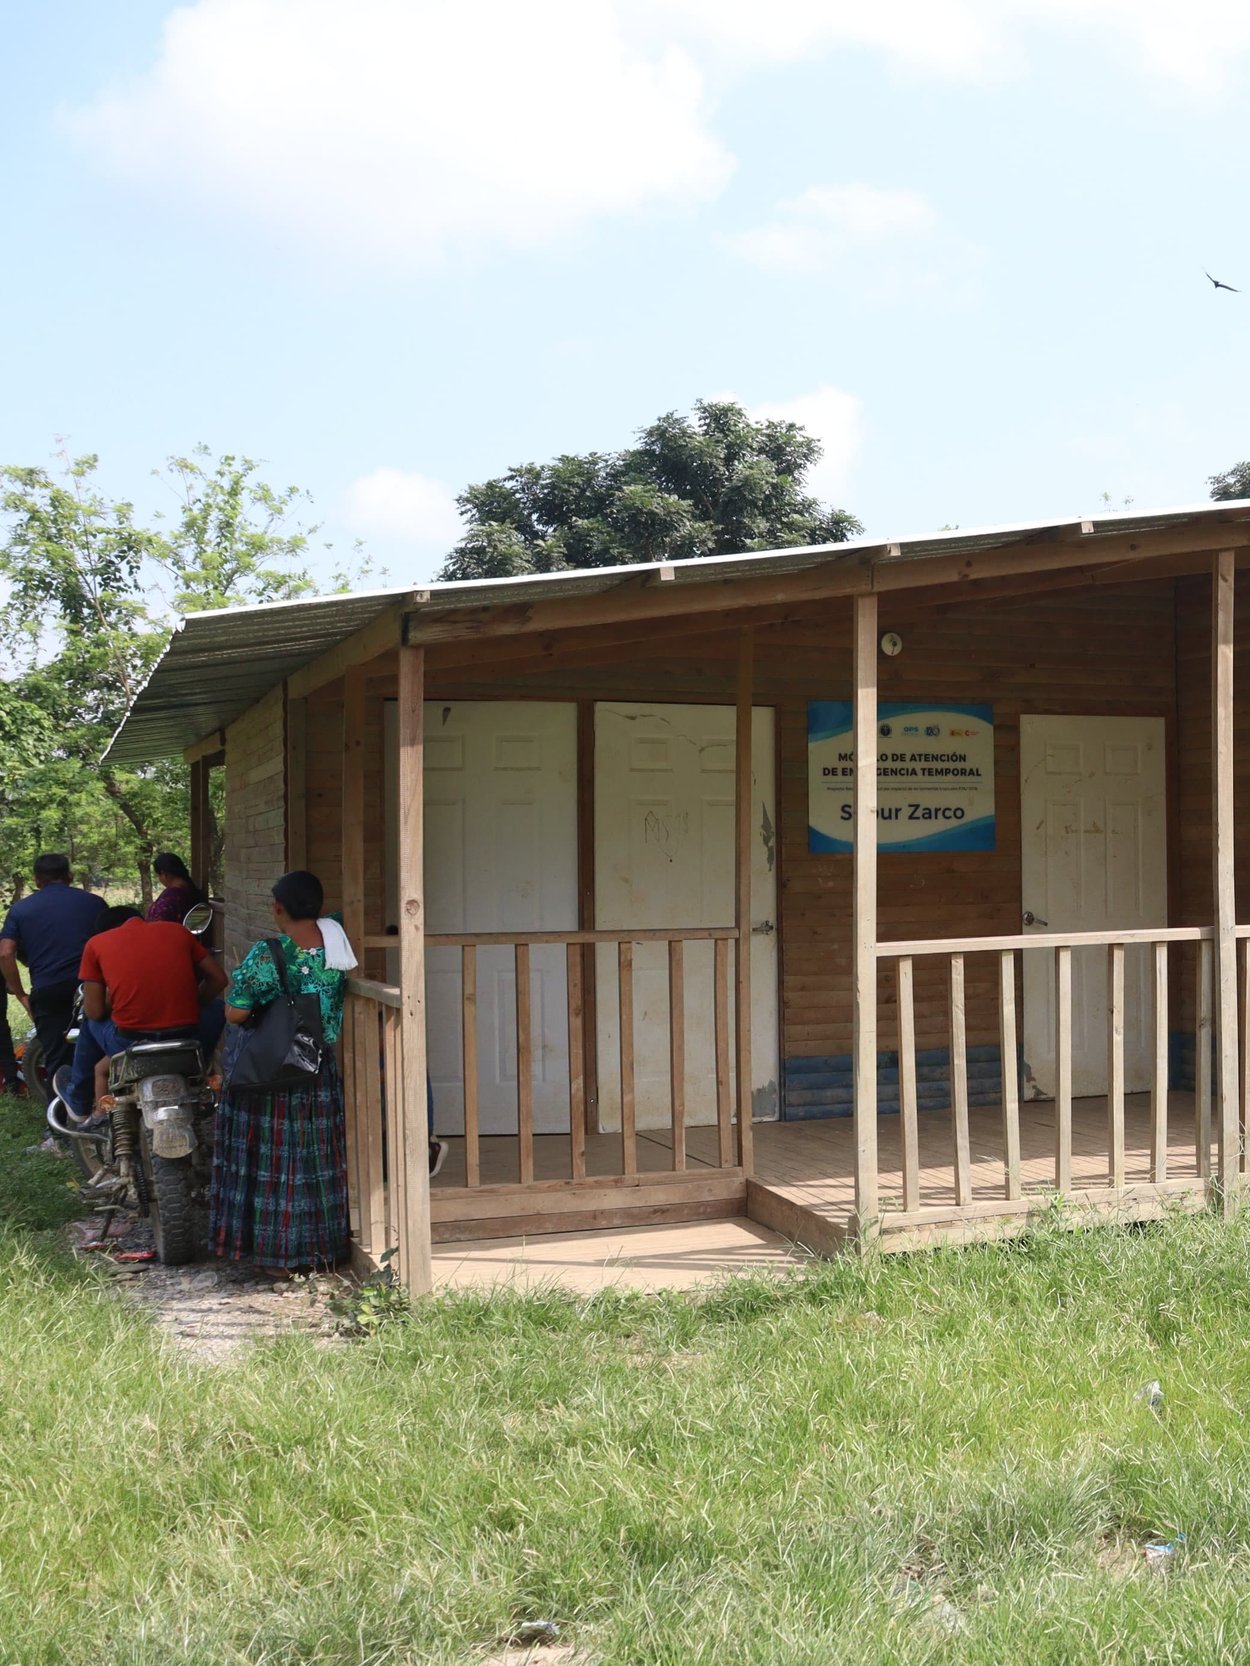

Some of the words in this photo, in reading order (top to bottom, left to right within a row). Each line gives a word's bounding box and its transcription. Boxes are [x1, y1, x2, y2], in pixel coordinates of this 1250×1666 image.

[838, 751, 888, 762] MÓO
[891, 753, 906, 762] DE
[909, 751, 966, 763] ATENCIÓN
[822, 767, 838, 777] DE
[841, 767, 918, 777] EMGENCIA
[920, 767, 982, 777] TEMPORAL
[840, 803, 902, 821] Sur
[908, 803, 965, 821] Zarco
